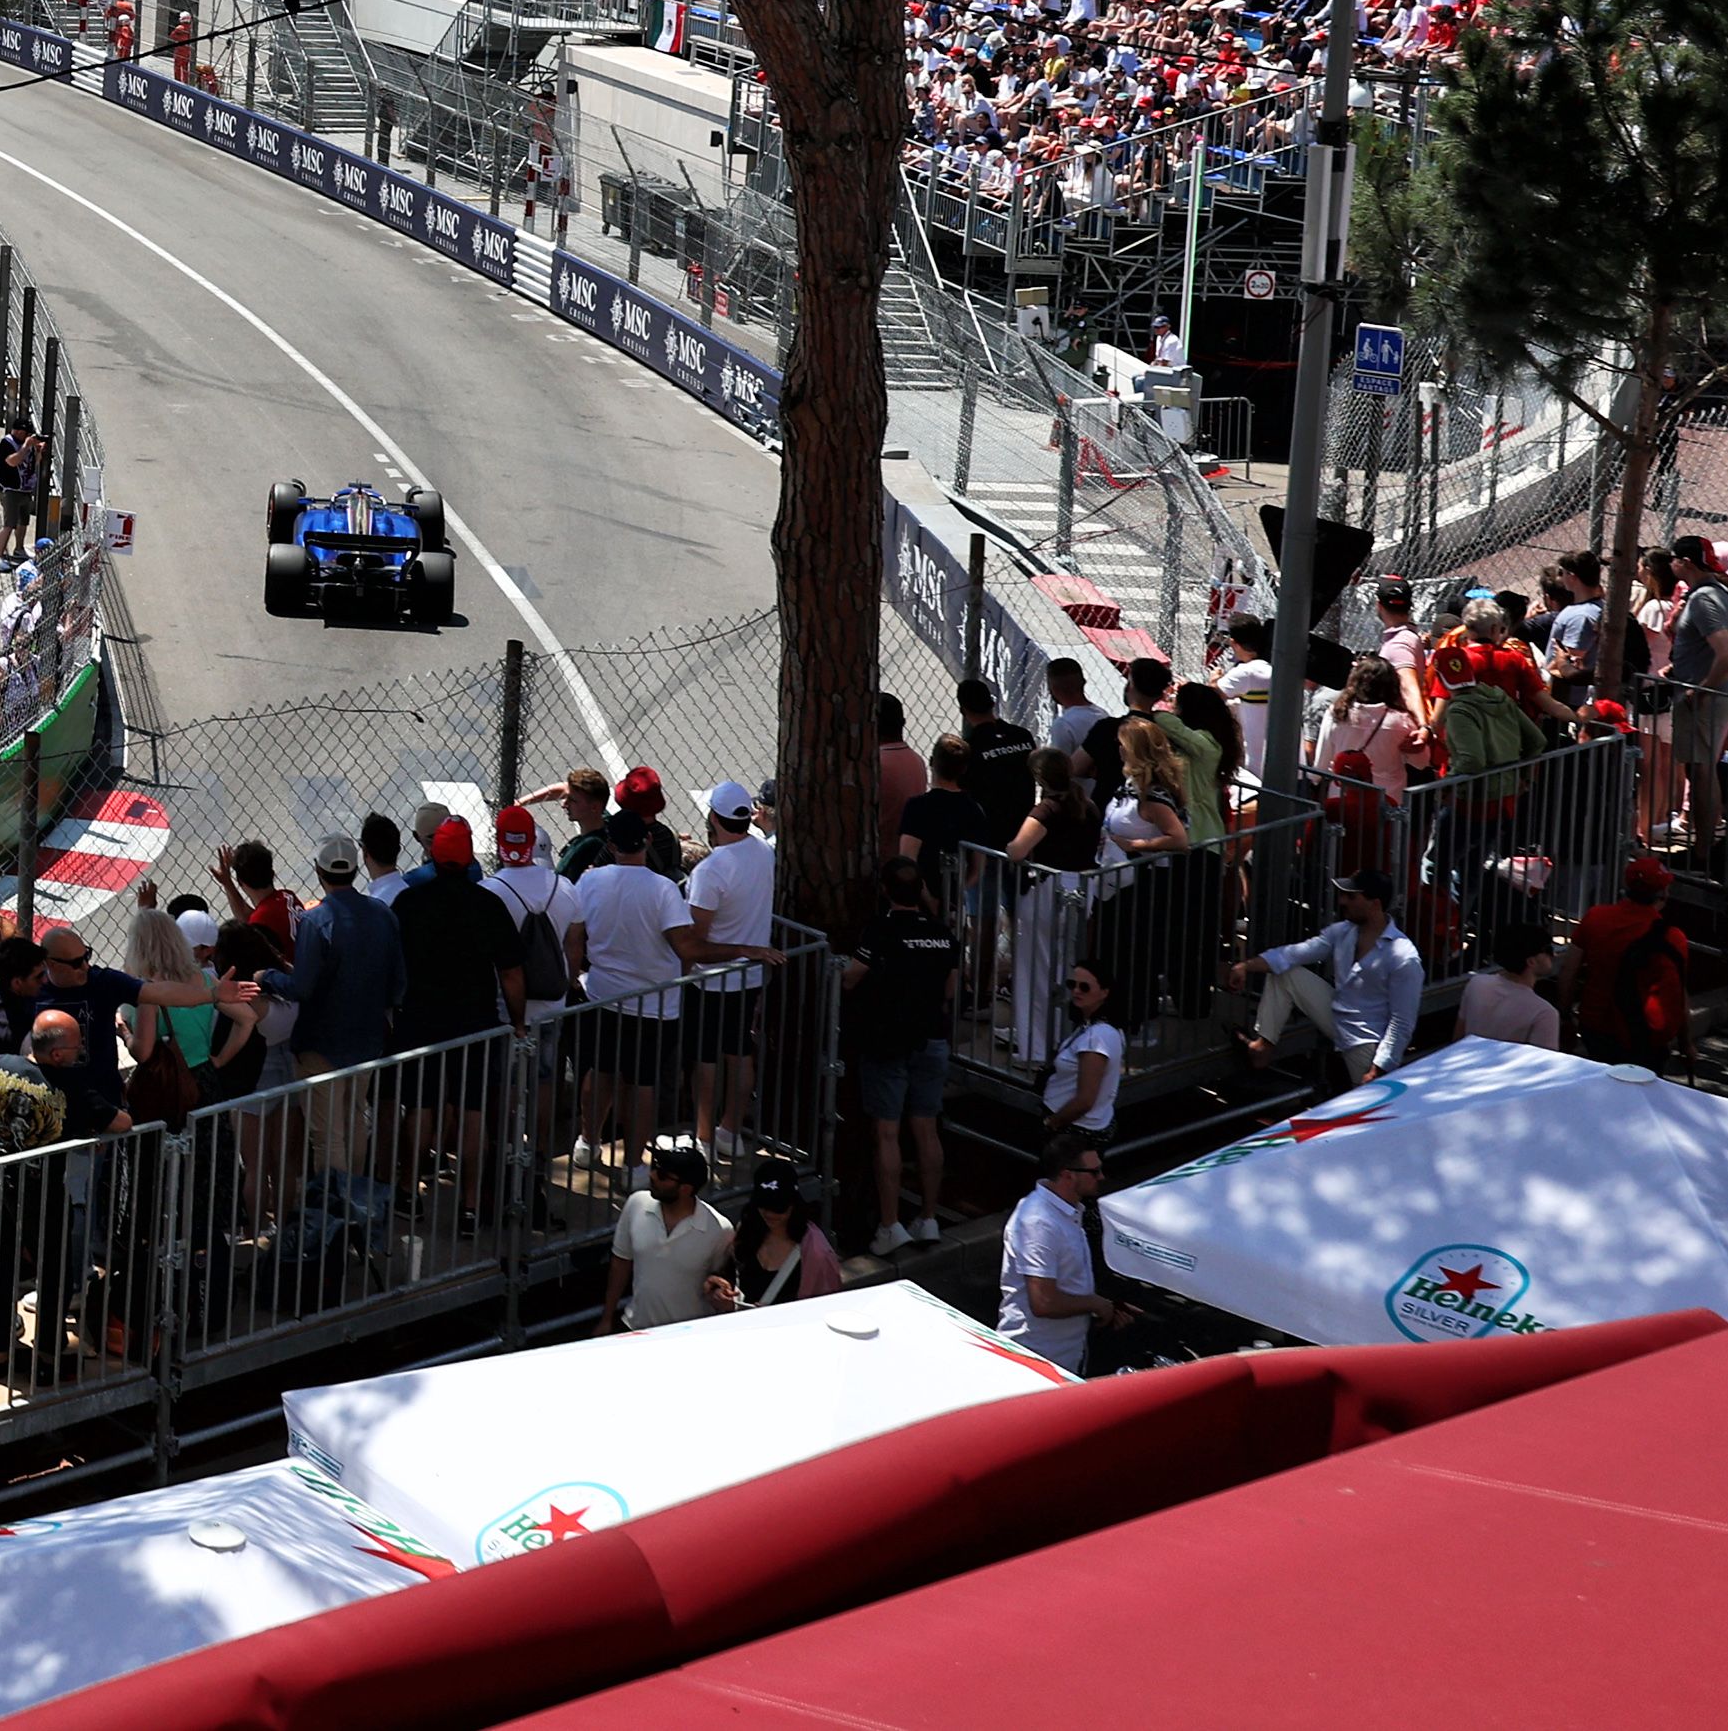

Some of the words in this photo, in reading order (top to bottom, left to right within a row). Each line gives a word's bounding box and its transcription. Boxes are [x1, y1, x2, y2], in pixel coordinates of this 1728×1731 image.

[2, 28, 22, 51] MSC
[42, 41, 63, 66] MSC
[128, 73, 149, 100] MSC
[173, 91, 195, 119] MSC
[215, 109, 237, 138] MSC
[258, 125, 280, 156] MSC
[302, 144, 325, 176] MSC
[345, 162, 368, 195] MSC
[390, 183, 414, 217] MSC
[436, 204, 460, 240] MSC
[483, 229, 509, 265] MSC
[570, 272, 598, 312] MSC
[624, 298, 652, 341] MSC
[678, 331, 707, 375] MSC
[1357, 383, 1396, 394] PARTAGE
[1359, 376, 1393, 387] ESPACE
[913, 544, 946, 621] MSC
[981, 741, 1033, 760] PETRONAS
[1401, 1301, 1471, 1334] SILVER
[1403, 1276, 1558, 1336] Heinek
